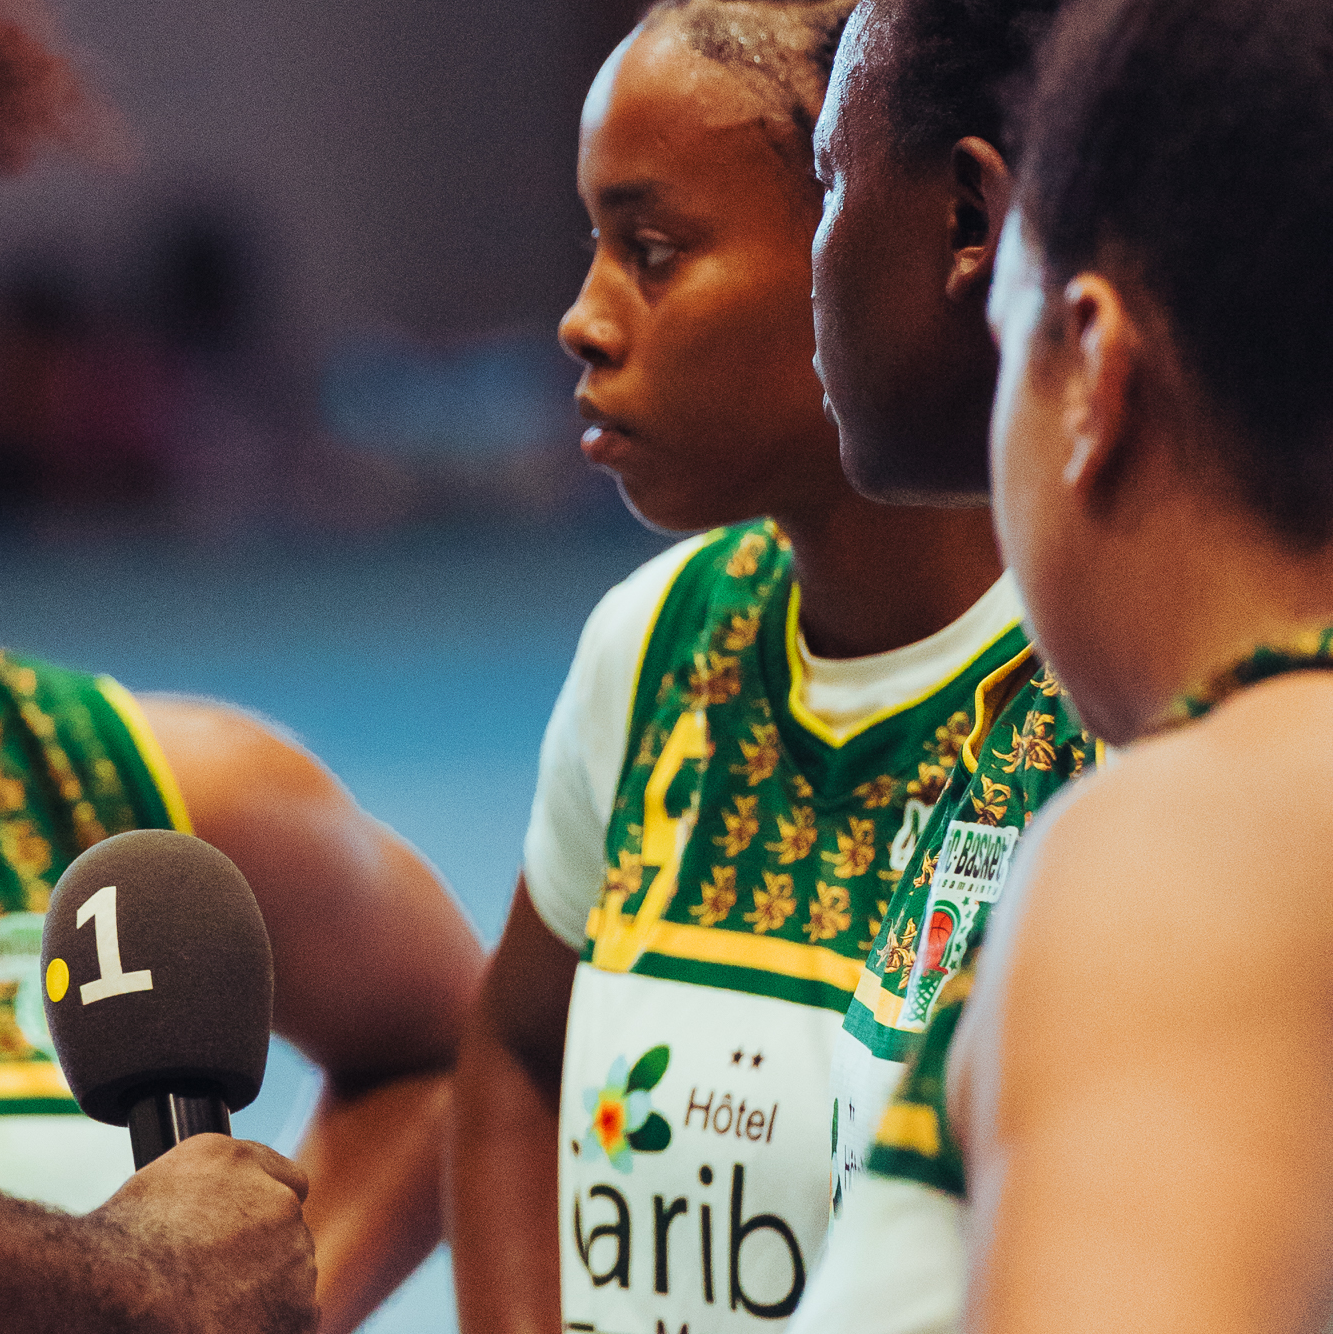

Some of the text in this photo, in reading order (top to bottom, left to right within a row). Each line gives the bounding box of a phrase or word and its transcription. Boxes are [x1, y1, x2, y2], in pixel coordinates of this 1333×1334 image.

[76, 886, 154, 1006] 1
[684, 1087, 779, 1145] Hôtel
[570, 1162, 807, 1320] arib
